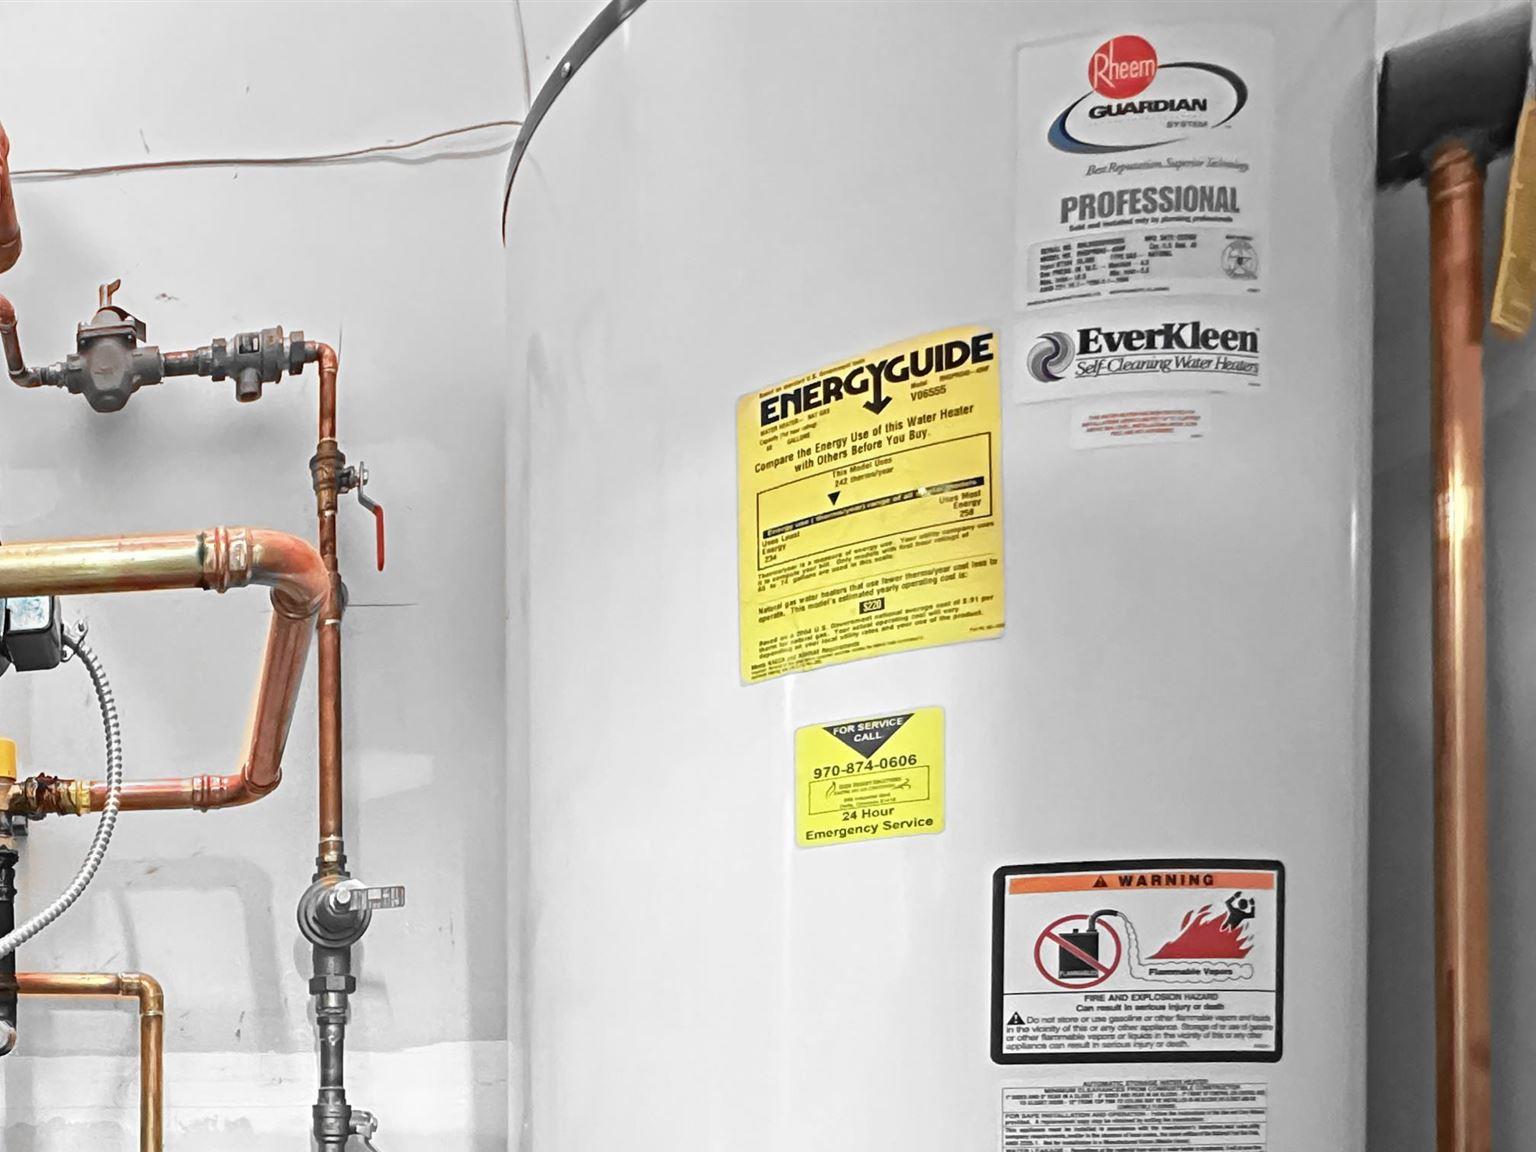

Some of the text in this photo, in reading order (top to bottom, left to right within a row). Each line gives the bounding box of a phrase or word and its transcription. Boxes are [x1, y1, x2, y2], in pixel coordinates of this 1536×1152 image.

[1093, 40, 1156, 89] Rheem
[1088, 98, 1208, 119] GUARDIAN
[1166, 120, 1209, 129] SYSTEM
[1060, 185, 1240, 223] PROFESSIONAL
[1076, 321, 1259, 355] EverKleen
[1075, 356, 1173, 377] Self-Cleaning
[1175, 355, 1212, 370] Water
[760, 332, 994, 427] ENERGYGUIDE
[755, 405, 973, 473] Compare the Energy Use of this Water Heater
[795, 459, 813, 472] with
[817, 450, 847, 465] Others
[852, 440, 882, 455] Before
[887, 435, 905, 445] You
[833, 717, 904, 735] FOR SERVICE
[854, 732, 882, 742] CALL
[814, 754, 917, 779] 970-874-0606
[842, 807, 895, 821] 24 Hour
[806, 817, 934, 841] Emergency Service
[1118, 873, 1215, 888] WARNING
[1149, 968, 1233, 976] Flammable Vapors
[1084, 994, 1106, 1002] FIRE
[1131, 993, 1182, 1001] EXPLOSION
[1184, 993, 1219, 1001] HAZARD
[1026, 1016, 1039, 1024] Do
